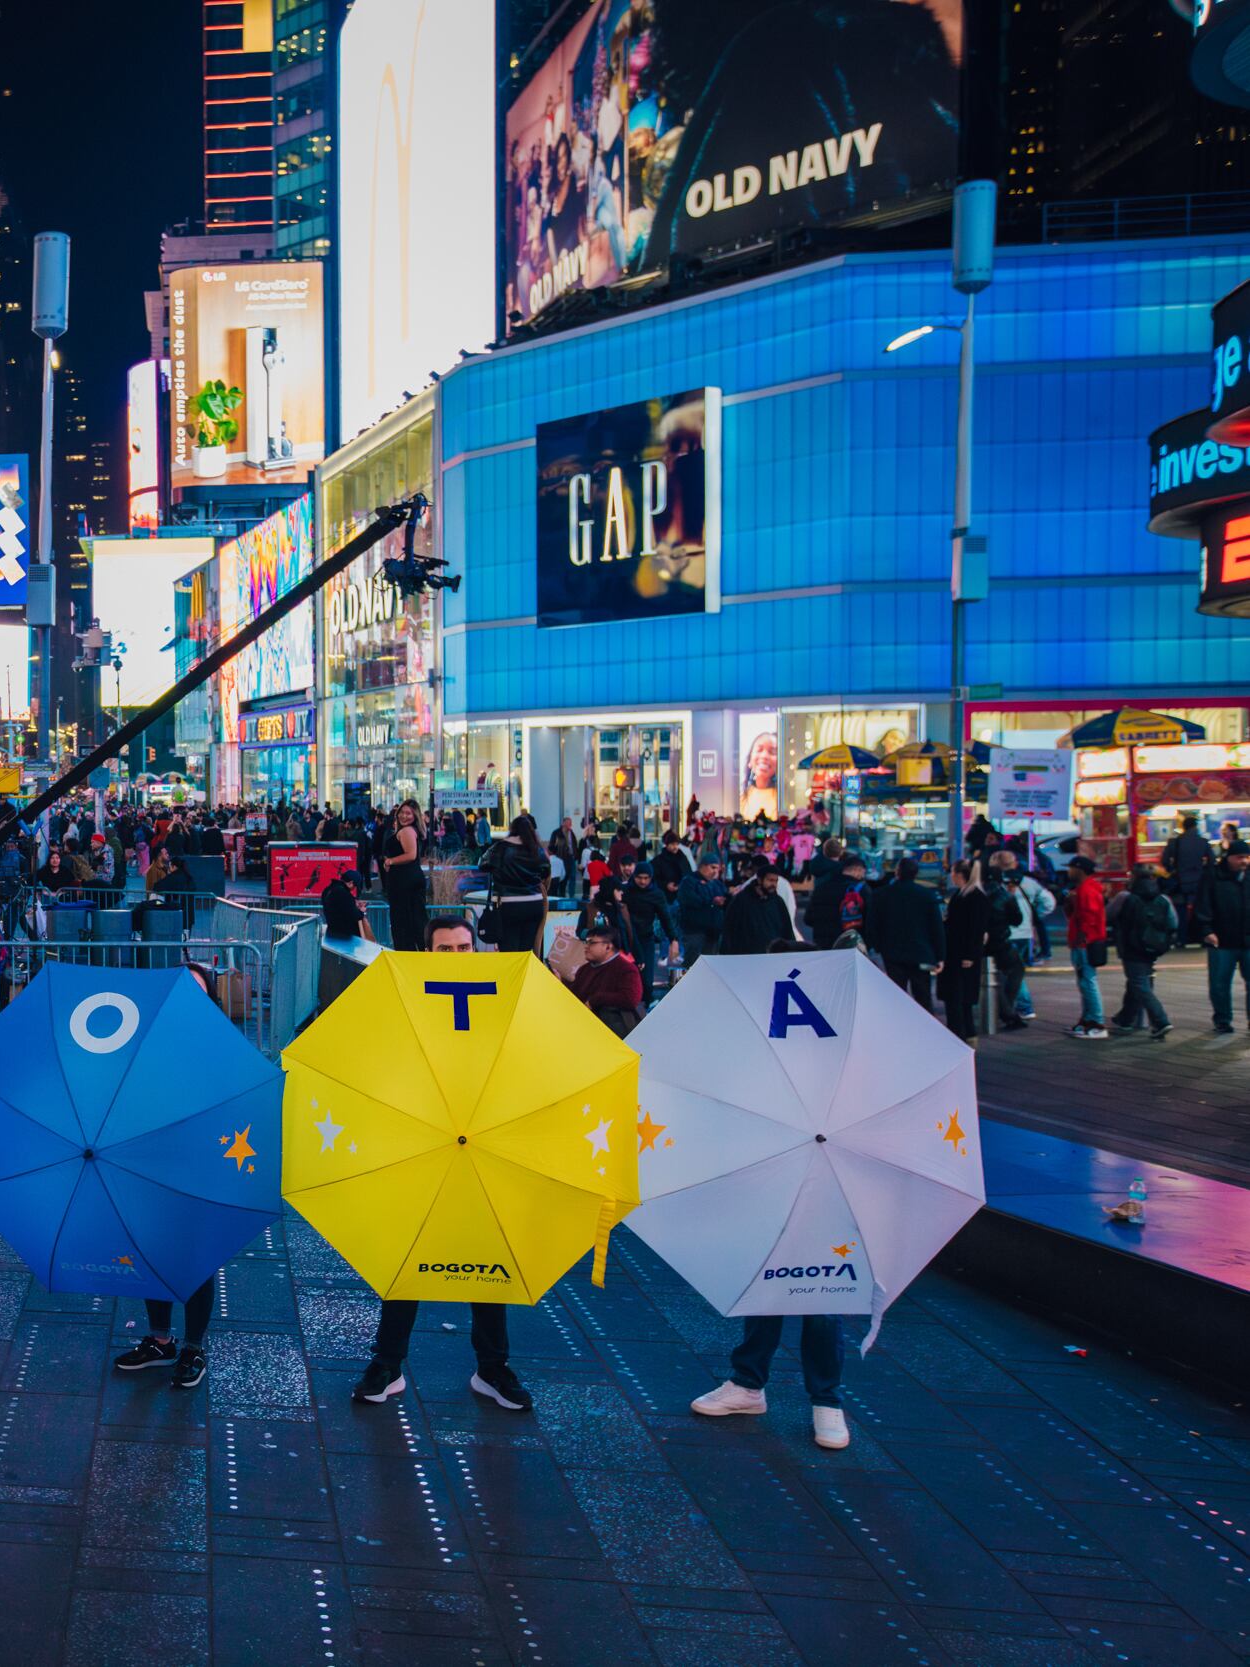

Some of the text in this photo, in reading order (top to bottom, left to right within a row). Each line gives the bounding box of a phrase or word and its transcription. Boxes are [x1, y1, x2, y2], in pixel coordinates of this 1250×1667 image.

[685, 123, 883, 219] OLD NAVY
[214, 272, 228, 281] LG
[235, 281, 250, 292] LG
[529, 240, 588, 315] OLD NAVY
[174, 290, 188, 466] Auto empties the dust
[1158, 438, 1250, 495] inves
[569, 460, 668, 567] GAP
[330, 583, 360, 636] OLD
[358, 724, 390, 746] OLD NAVY
[69, 992, 140, 1054] O
[424, 981, 497, 1031] T
[768, 968, 838, 1039] Á
[444, 1274, 512, 1285] your home
[788, 1287, 816, 1295] your
